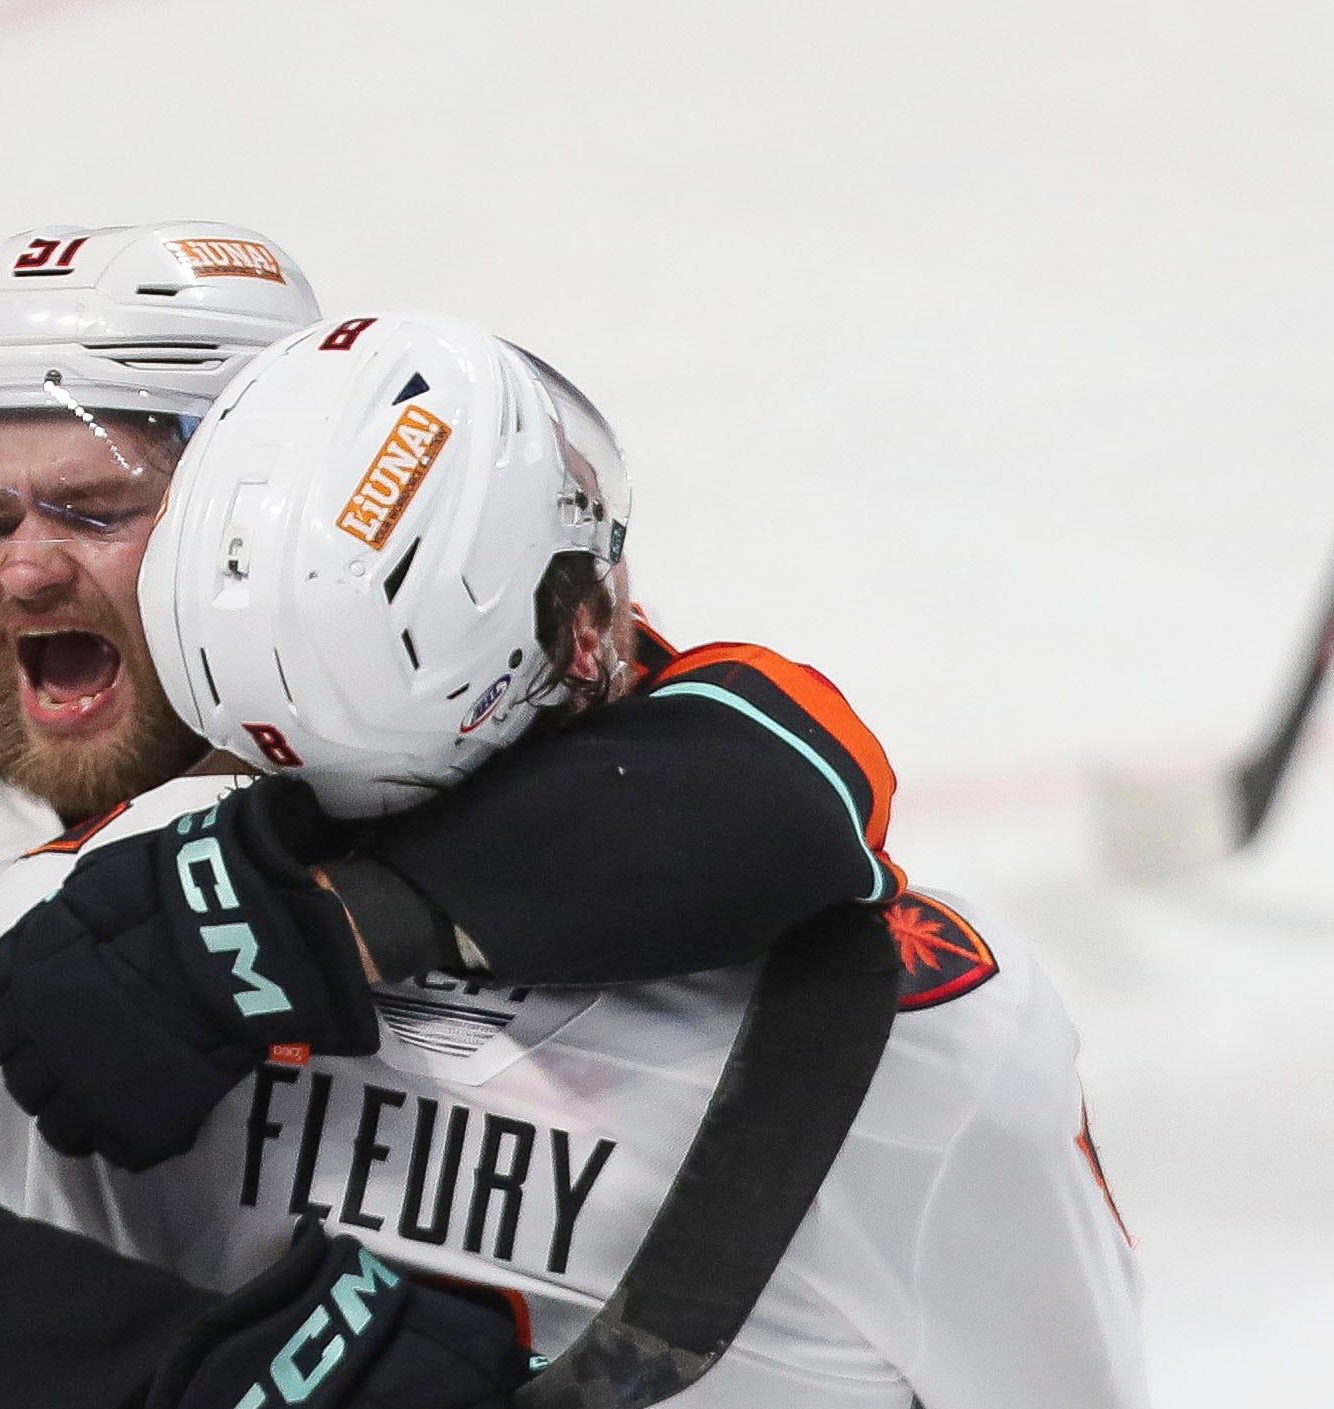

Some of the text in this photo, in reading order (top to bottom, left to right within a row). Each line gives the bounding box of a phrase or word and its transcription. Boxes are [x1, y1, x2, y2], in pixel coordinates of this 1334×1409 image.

[319, 318, 378, 350] 8
[241, 722, 304, 768] 8
[239, 1064, 618, 1274] FLEURY
